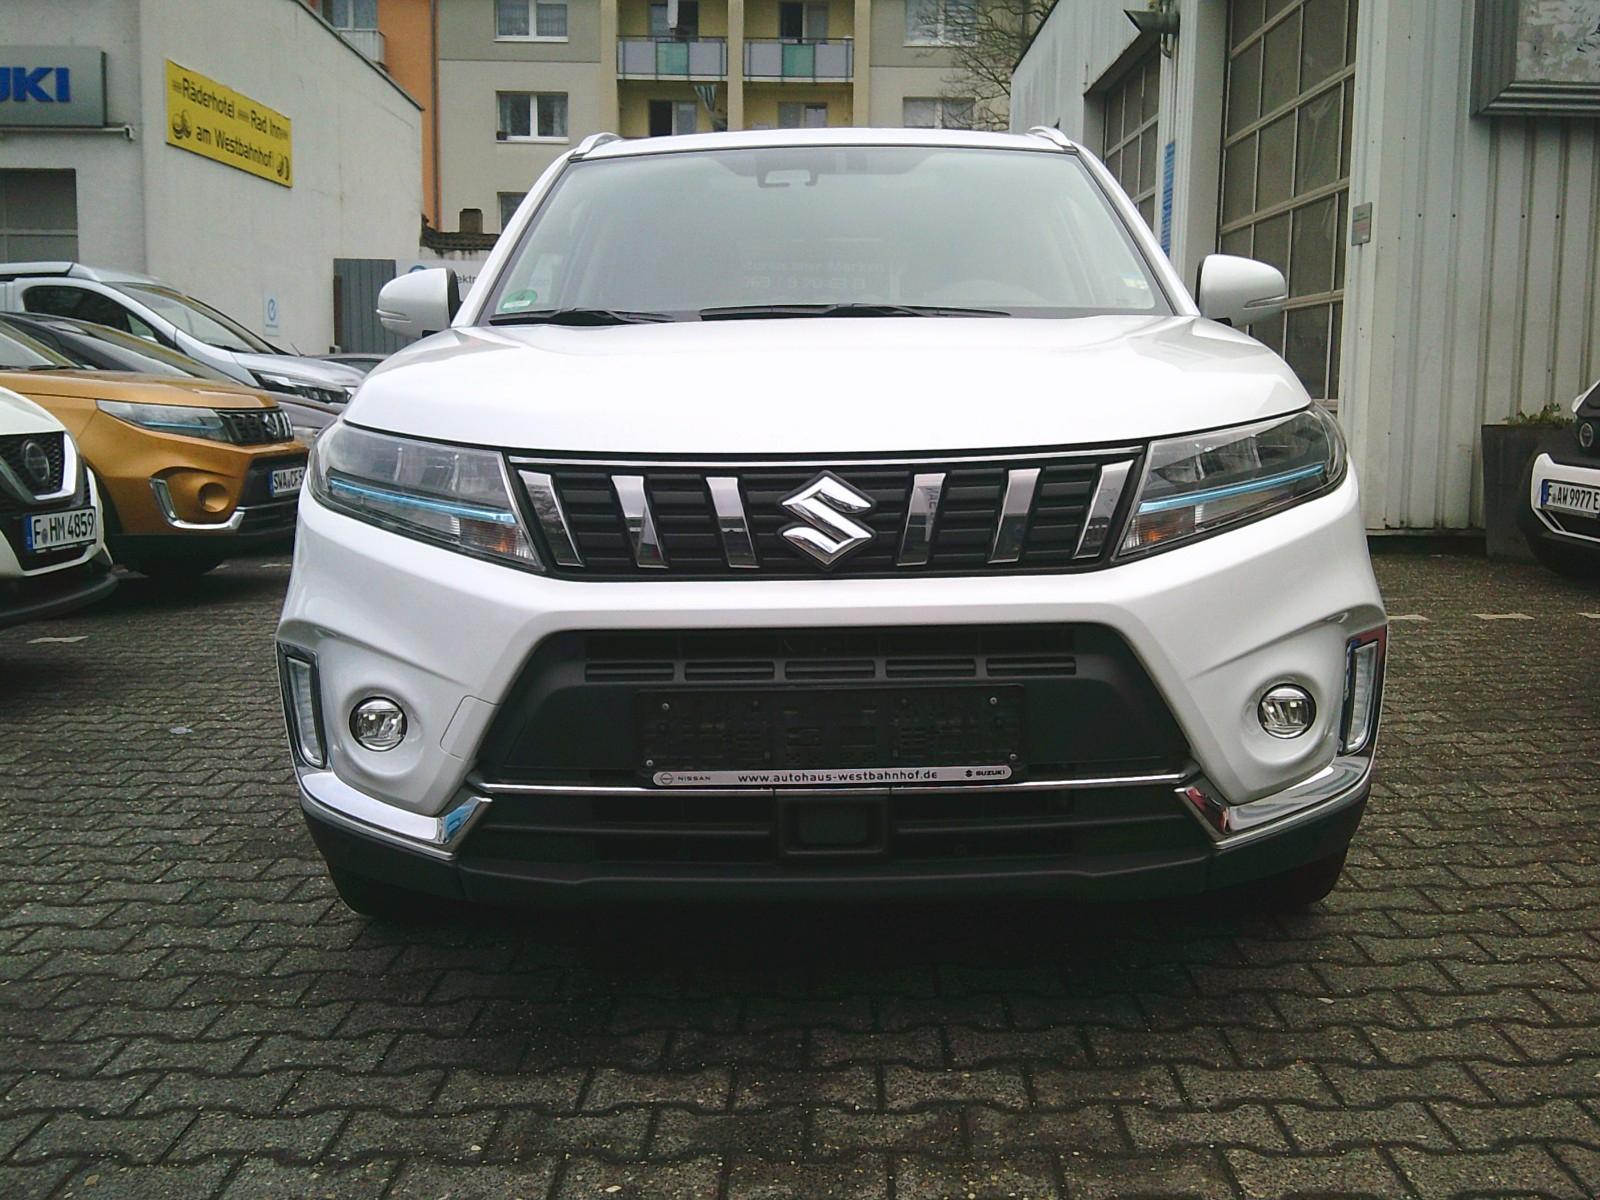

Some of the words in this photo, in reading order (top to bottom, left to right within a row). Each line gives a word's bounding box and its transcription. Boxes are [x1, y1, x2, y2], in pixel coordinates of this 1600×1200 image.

[182, 77, 235, 120] Räderhotel
[251, 109, 267, 134] Rad
[195, 126, 211, 144] am
[214, 127, 273, 168] Westbahnhof
[33, 518, 42, 545] F
[49, 516, 66, 542] HM
[67, 512, 95, 540] 4859
[677, 774, 712, 782] NISSAN
[737, 769, 938, 784] www.autohaus-westbahnhof.de
[975, 769, 1006, 777] SUZUKI
